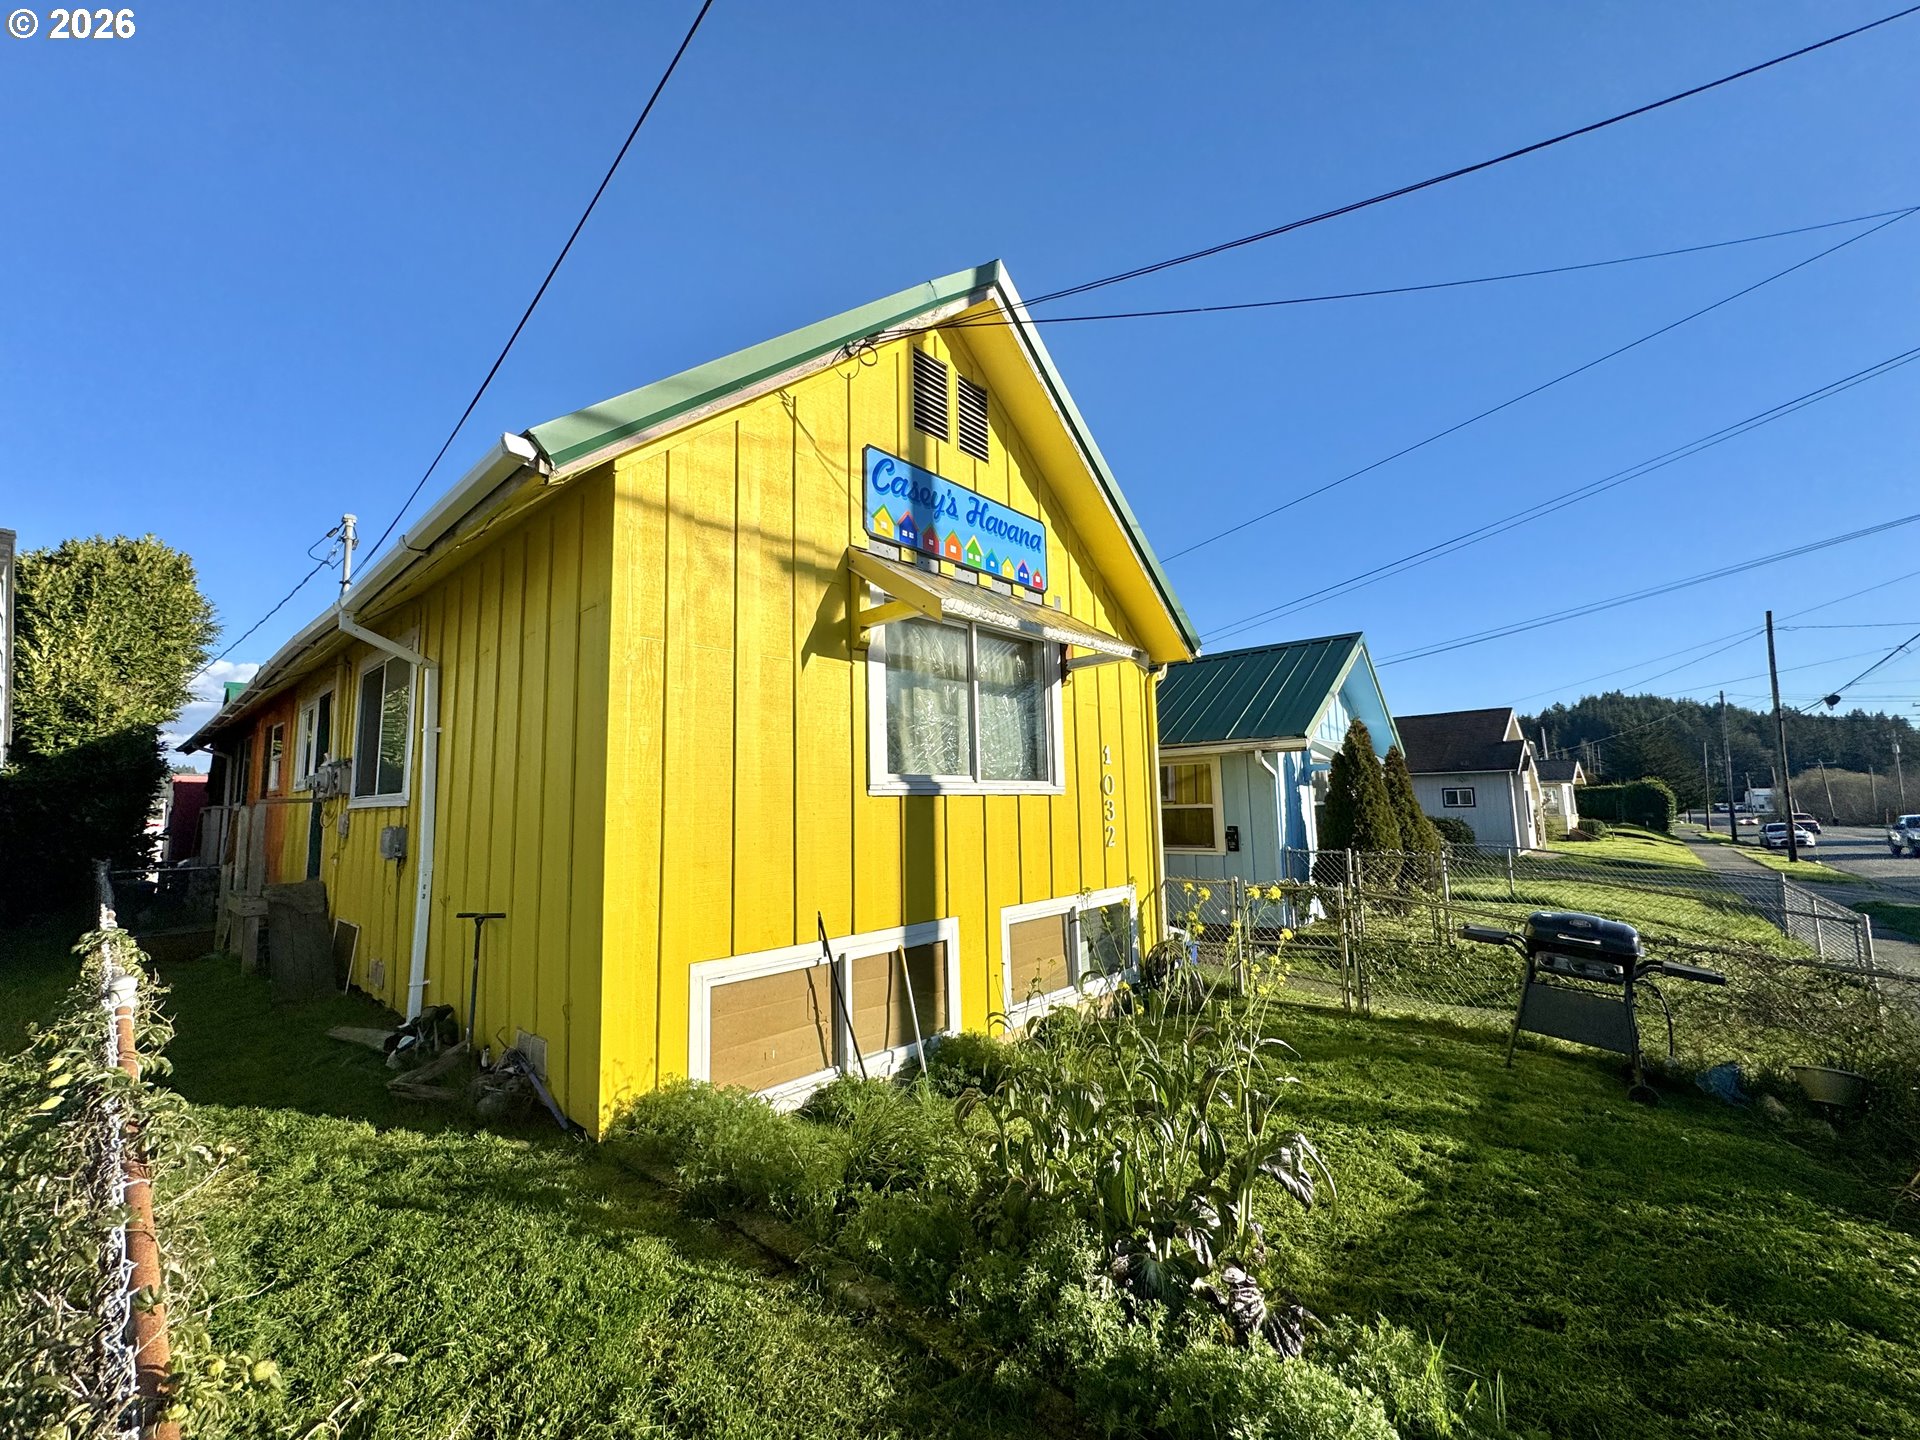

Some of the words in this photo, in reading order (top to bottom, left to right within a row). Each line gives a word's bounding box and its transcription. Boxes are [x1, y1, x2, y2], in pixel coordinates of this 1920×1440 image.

[872, 458, 959, 519] Casey's
[966, 496, 1042, 553] Havana
[1102, 744, 1116, 848] 1032
